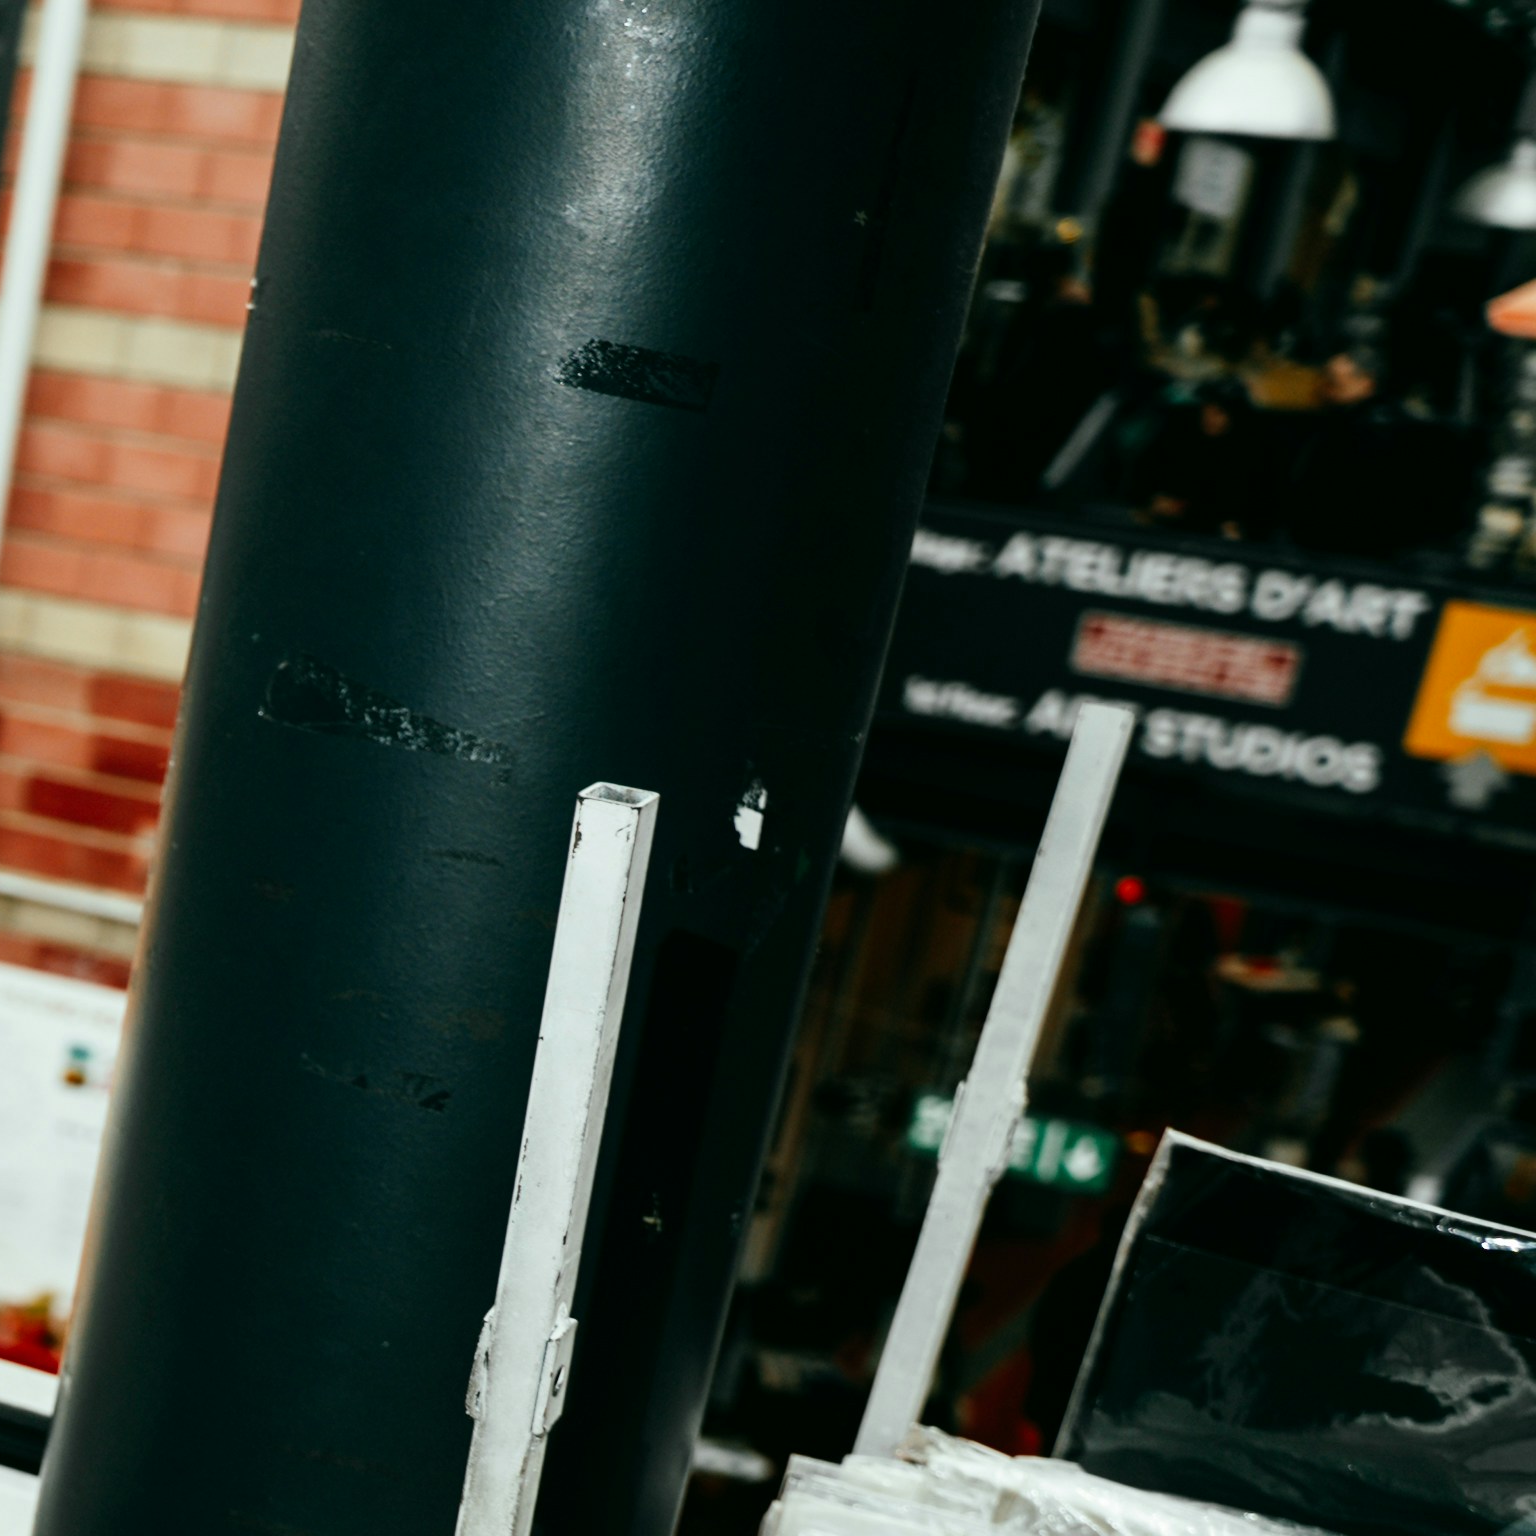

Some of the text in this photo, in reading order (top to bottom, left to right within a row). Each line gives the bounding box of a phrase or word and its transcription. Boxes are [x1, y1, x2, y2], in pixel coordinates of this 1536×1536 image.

[994, 531, 1249, 614] ATELIERS
[1251, 569, 1428, 640] D'ART
[1140, 707, 1382, 793] STUDIOS
